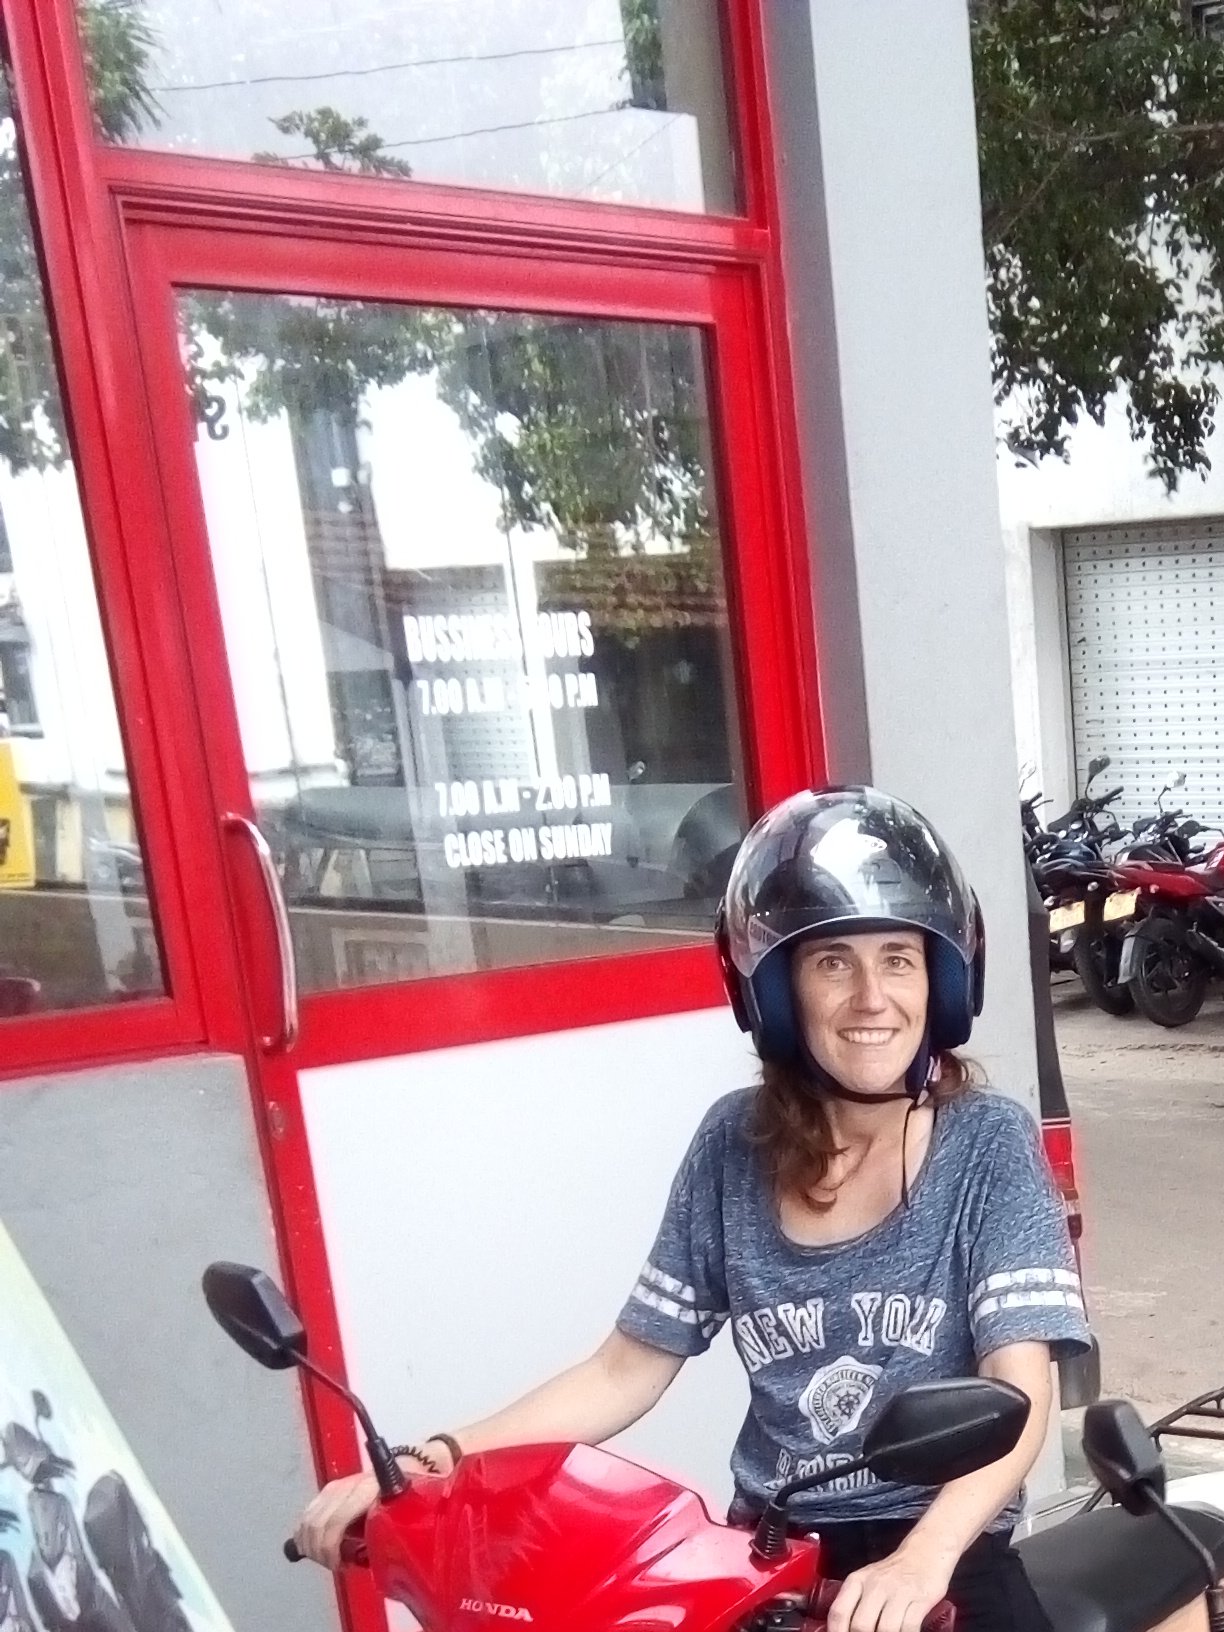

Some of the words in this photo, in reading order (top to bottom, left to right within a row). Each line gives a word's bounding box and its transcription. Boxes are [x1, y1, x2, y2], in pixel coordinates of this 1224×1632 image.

[403, 613, 527, 662] BUSSINES
[526, 610, 595, 659] OURS
[434, 780, 481, 817] 7.00
[482, 778, 521, 815] A.M
[535, 774, 577, 812] 2.00
[578, 773, 612, 808] P.M
[444, 829, 507, 868] CLOSE
[508, 827, 537, 862] ON
[538, 822, 612, 860] SUNDAY
[735, 1297, 826, 1374] NEW
[459, 1598, 534, 1623] HONDA
